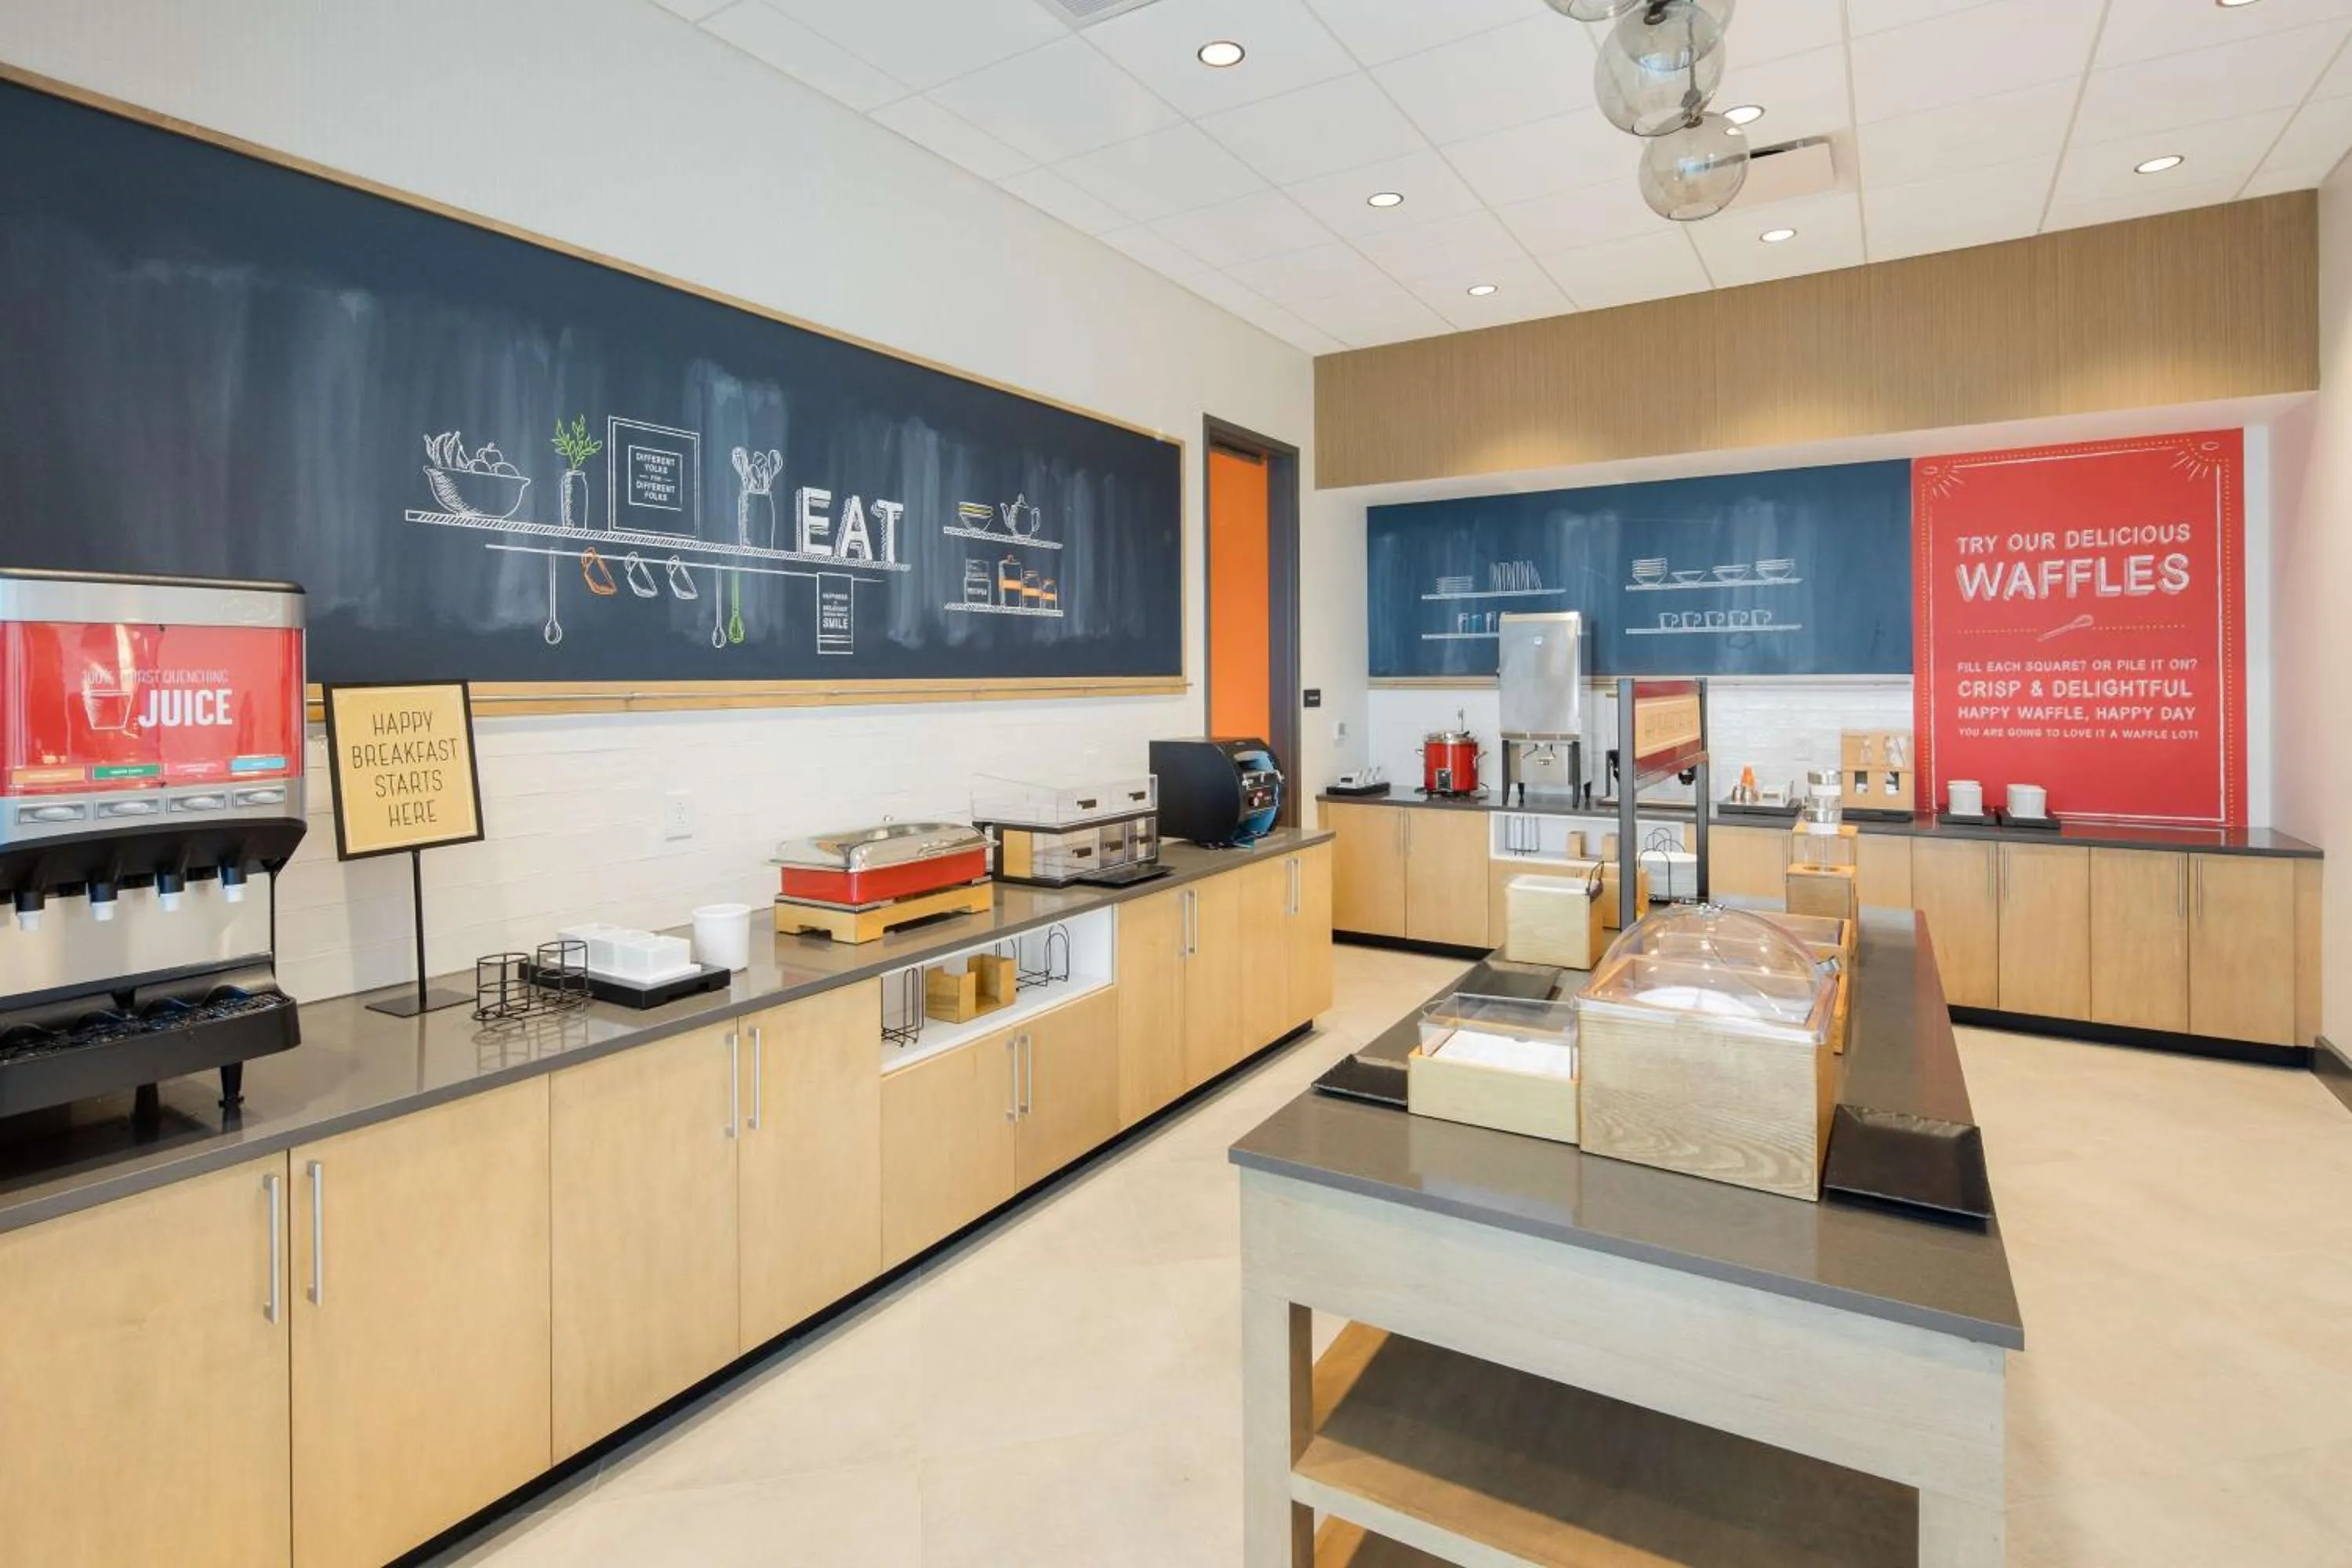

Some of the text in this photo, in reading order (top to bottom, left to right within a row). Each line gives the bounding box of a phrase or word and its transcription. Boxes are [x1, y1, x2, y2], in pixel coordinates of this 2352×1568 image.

[636, 452, 675, 466] DIFFERENT
[644, 463, 668, 474] YOLKS
[636, 480, 675, 494] DIFFERENT
[644, 491, 667, 501] FOLKS
[796, 486, 904, 563] EAT
[1956, 523, 2190, 554] TRY OUR DELICIOUS
[1955, 553, 2190, 602] WAFFLES
[822, 617, 848, 630] SMILE
[1958, 659, 2198, 673] FILL EACH SQUARE? OR PILE IT ON?
[1958, 679, 2194, 699] CRISP & DELIGHTFUL
[138, 689, 233, 728] JUICE
[1958, 706, 2196, 721] HAPPY WAFFLE, HAPPY DAY
[372, 710, 433, 735] HAPPY
[1959, 728, 1980, 737] YOU
[1983, 728, 2004, 737] ARE
[2008, 728, 2042, 738] GOING
[2046, 728, 2060, 738] TO
[2063, 729, 2092, 739] LOVE
[2095, 729, 2106, 739] IT
[2110, 729, 2118, 739] A
[2122, 729, 2168, 739] WAFFLE
[352, 739, 458, 768] BREAKFAST
[375, 770, 443, 797] STARTS
[388, 800, 437, 828] HERE
